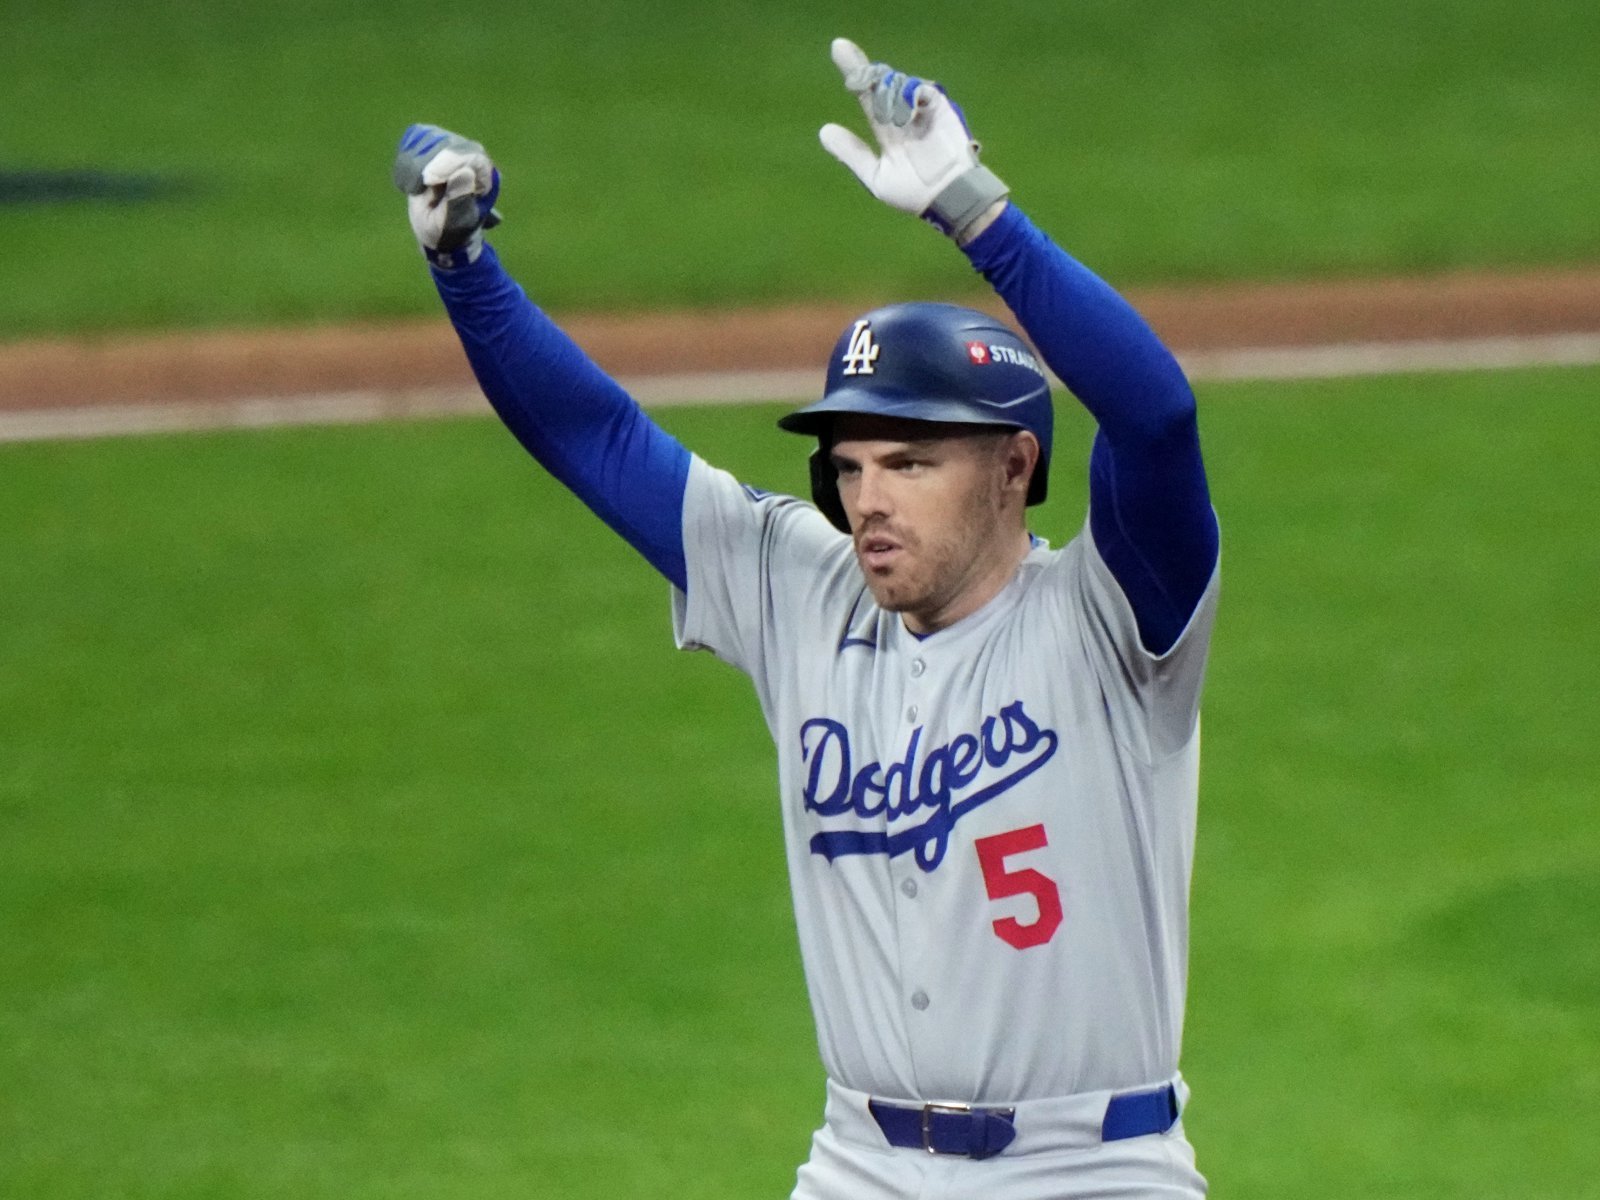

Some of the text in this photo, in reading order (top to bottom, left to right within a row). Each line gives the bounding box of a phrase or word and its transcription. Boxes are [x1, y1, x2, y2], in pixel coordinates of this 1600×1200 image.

[842, 320, 880, 375] LA
[800, 700, 1058, 873] Dodgers
[974, 823, 1063, 950] 5
